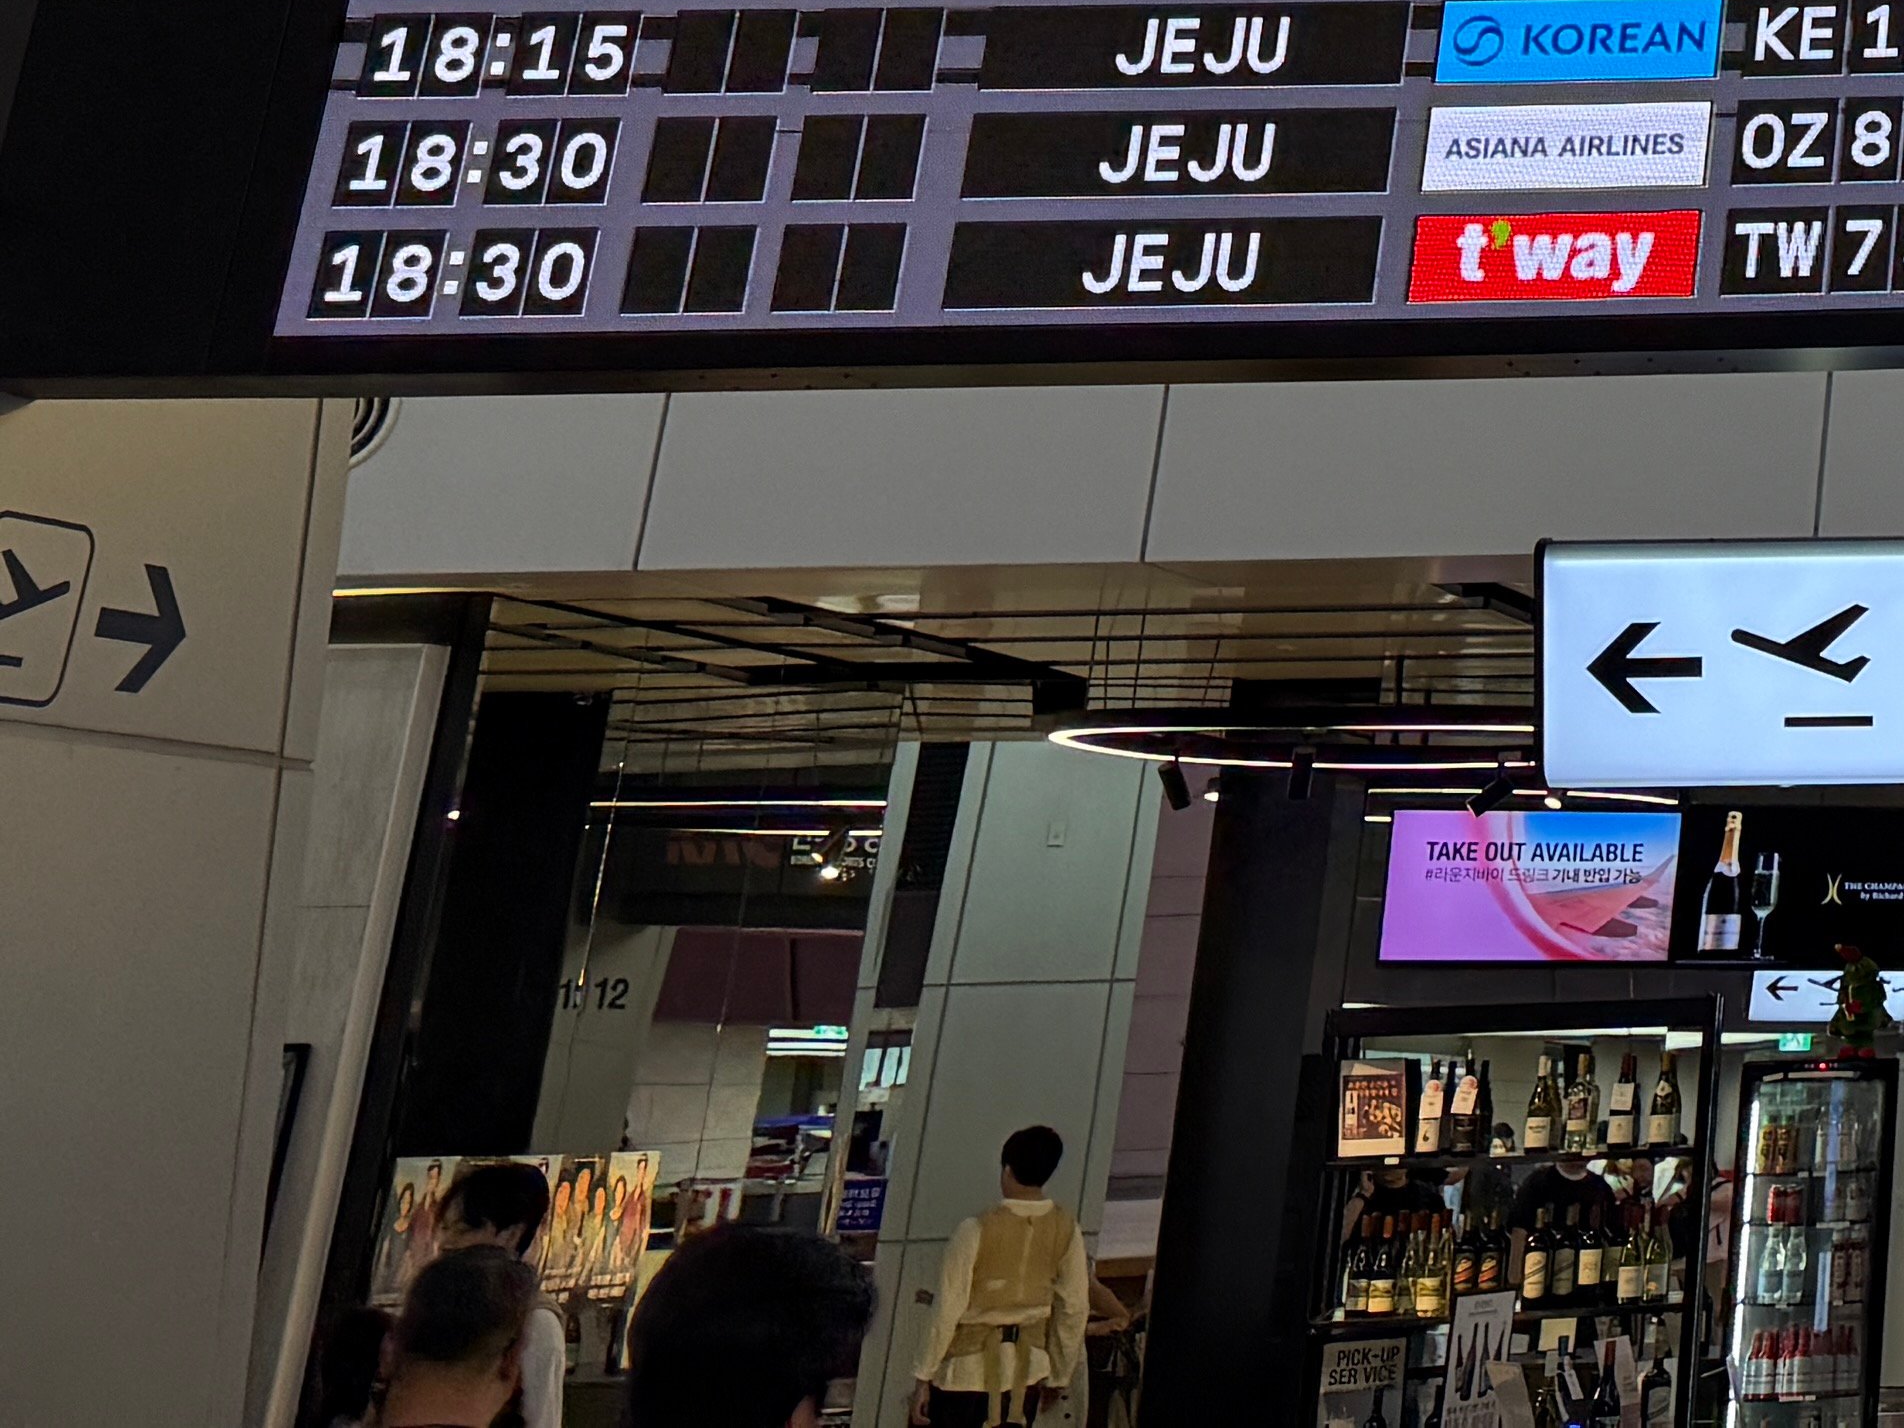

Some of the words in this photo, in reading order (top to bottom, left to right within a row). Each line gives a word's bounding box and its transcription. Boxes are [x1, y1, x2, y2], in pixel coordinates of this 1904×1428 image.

[324, 242, 585, 302] 18:30
[1082, 232, 1261, 294] JEJU
[1455, 219, 1655, 297] t'way
[1426, 841, 1478, 862] TAKE
[1484, 842, 1527, 862] OUT
[1530, 843, 1644, 863] AVAILABLE
[1552, 867, 1580, 884] 기내
[1337, 1345, 1400, 1367] PICK-UP
